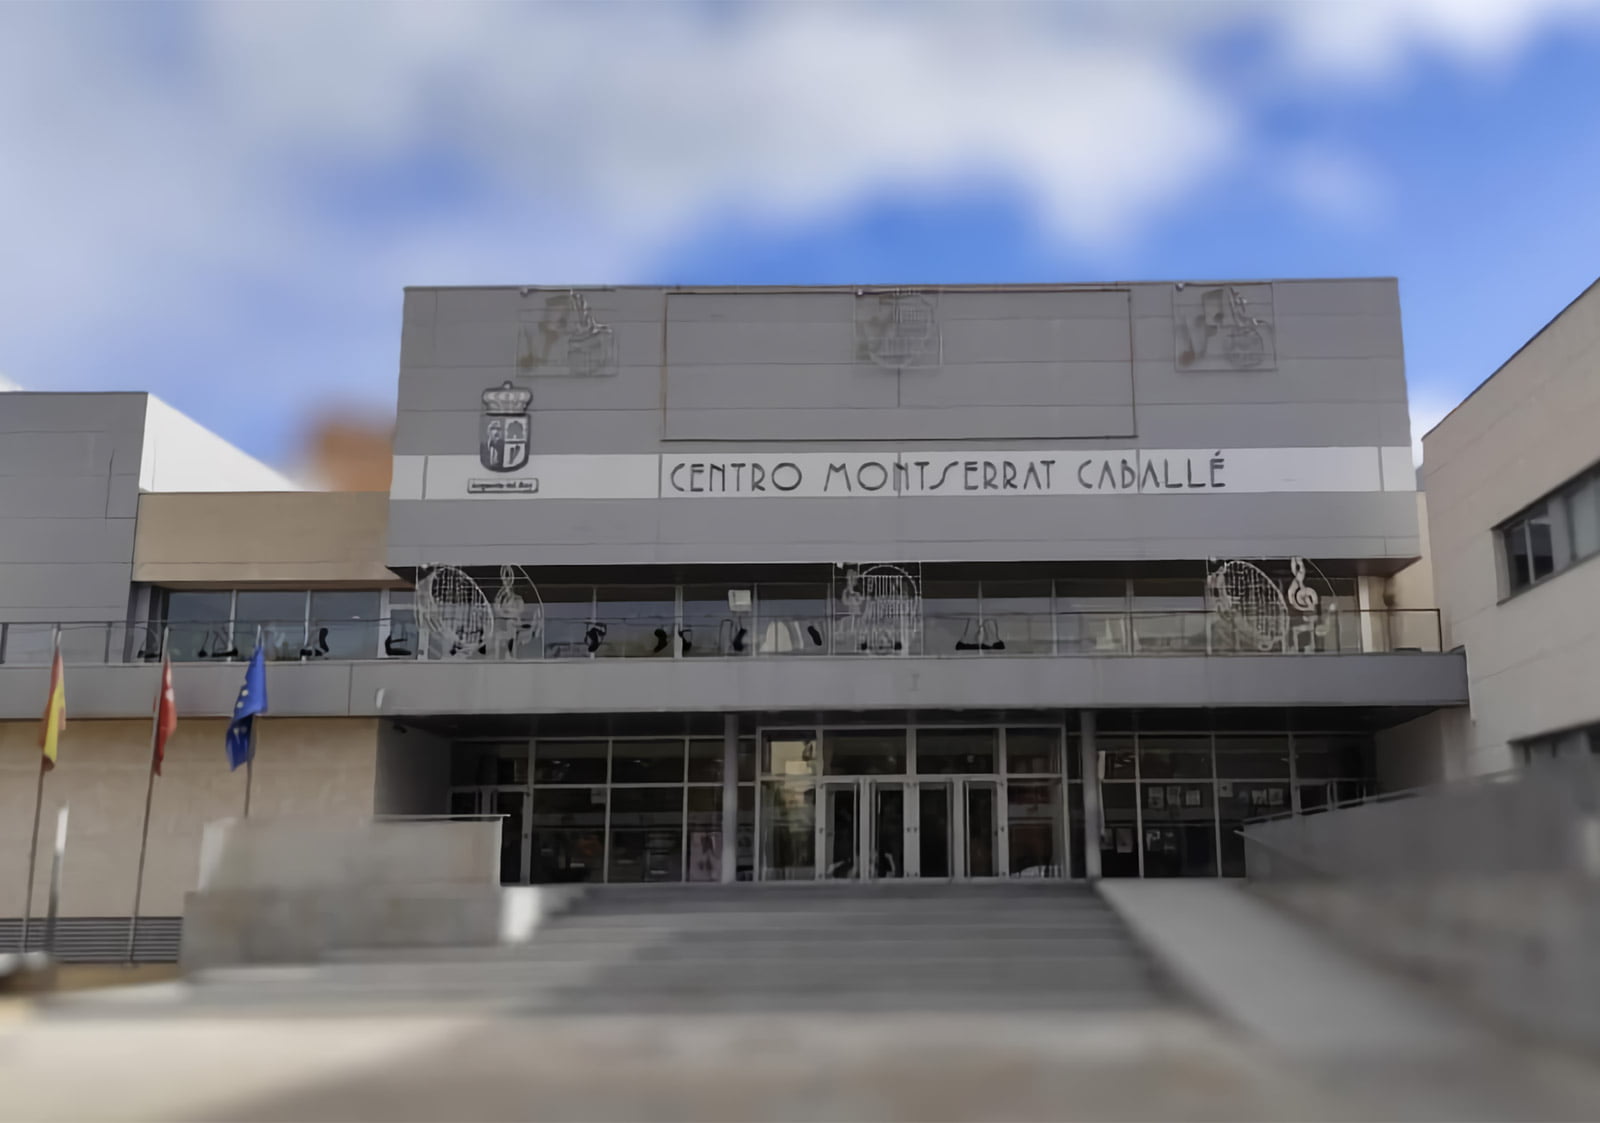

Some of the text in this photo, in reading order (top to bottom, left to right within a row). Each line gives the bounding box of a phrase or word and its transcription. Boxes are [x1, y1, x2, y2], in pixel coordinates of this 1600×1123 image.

[671, 450, 1226, 492] CENTRO MONTSERRAT CABALLÉ
